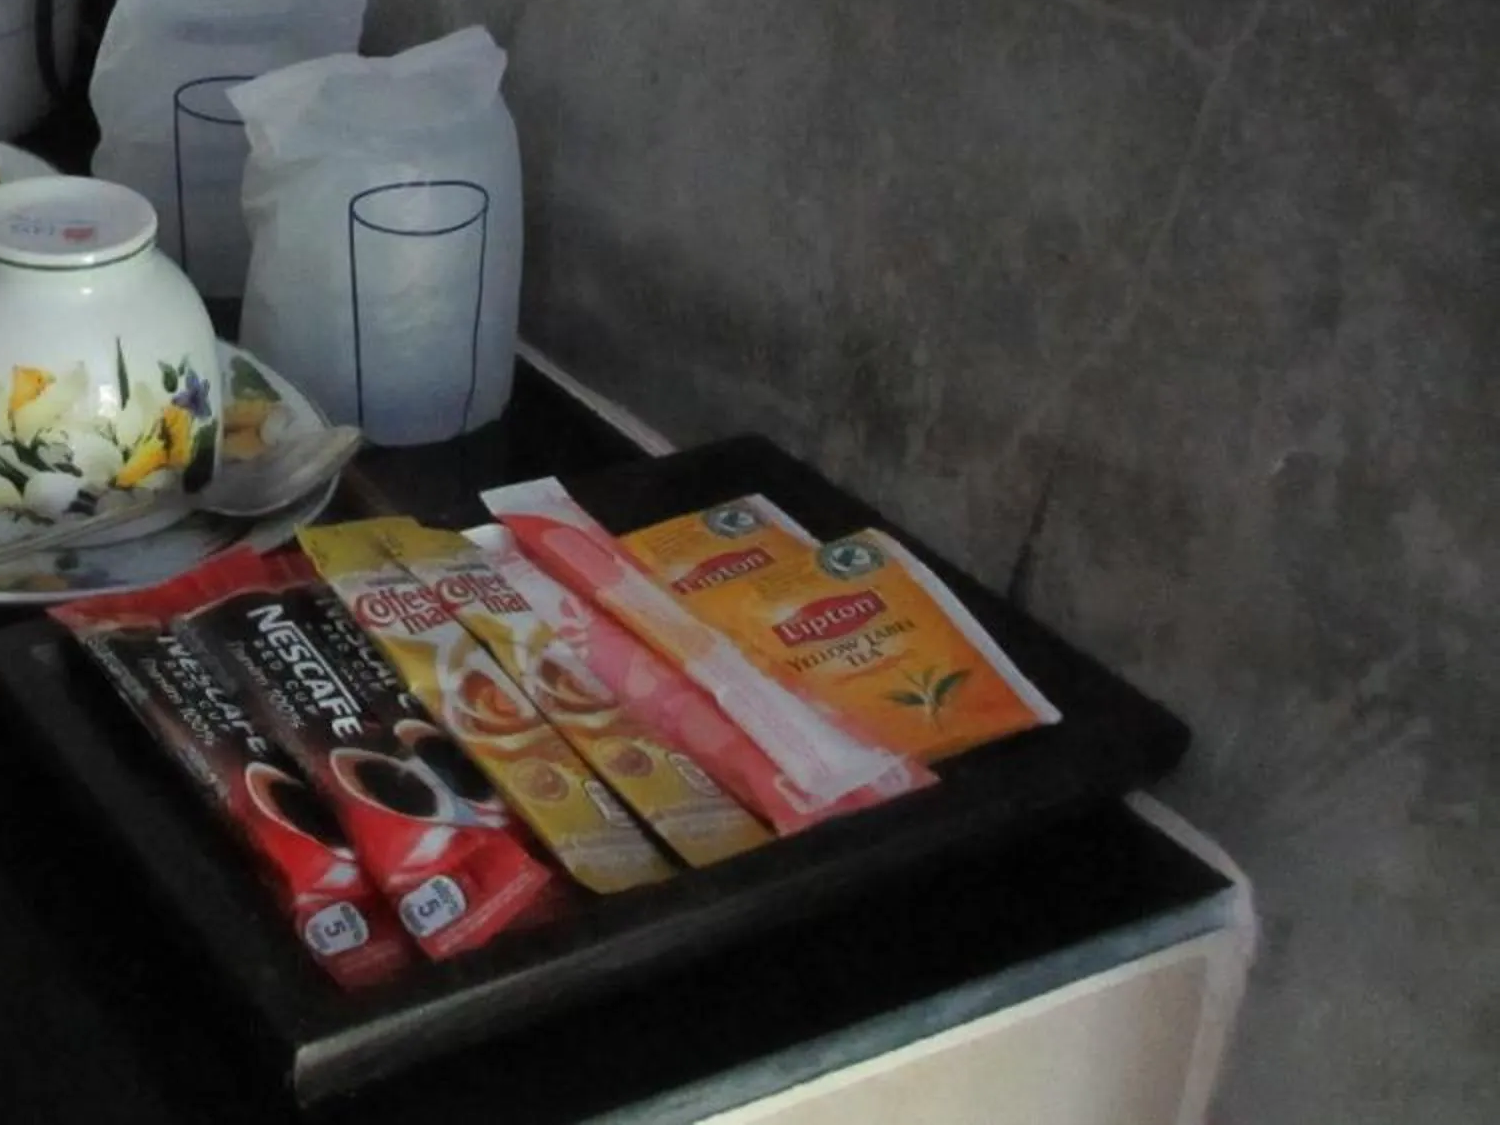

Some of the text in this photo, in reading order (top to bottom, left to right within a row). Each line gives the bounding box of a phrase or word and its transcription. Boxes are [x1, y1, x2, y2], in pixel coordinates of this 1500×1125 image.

[779, 595, 878, 641] Lipton
[417, 898, 442, 918] 5
[323, 920, 346, 938] 5
